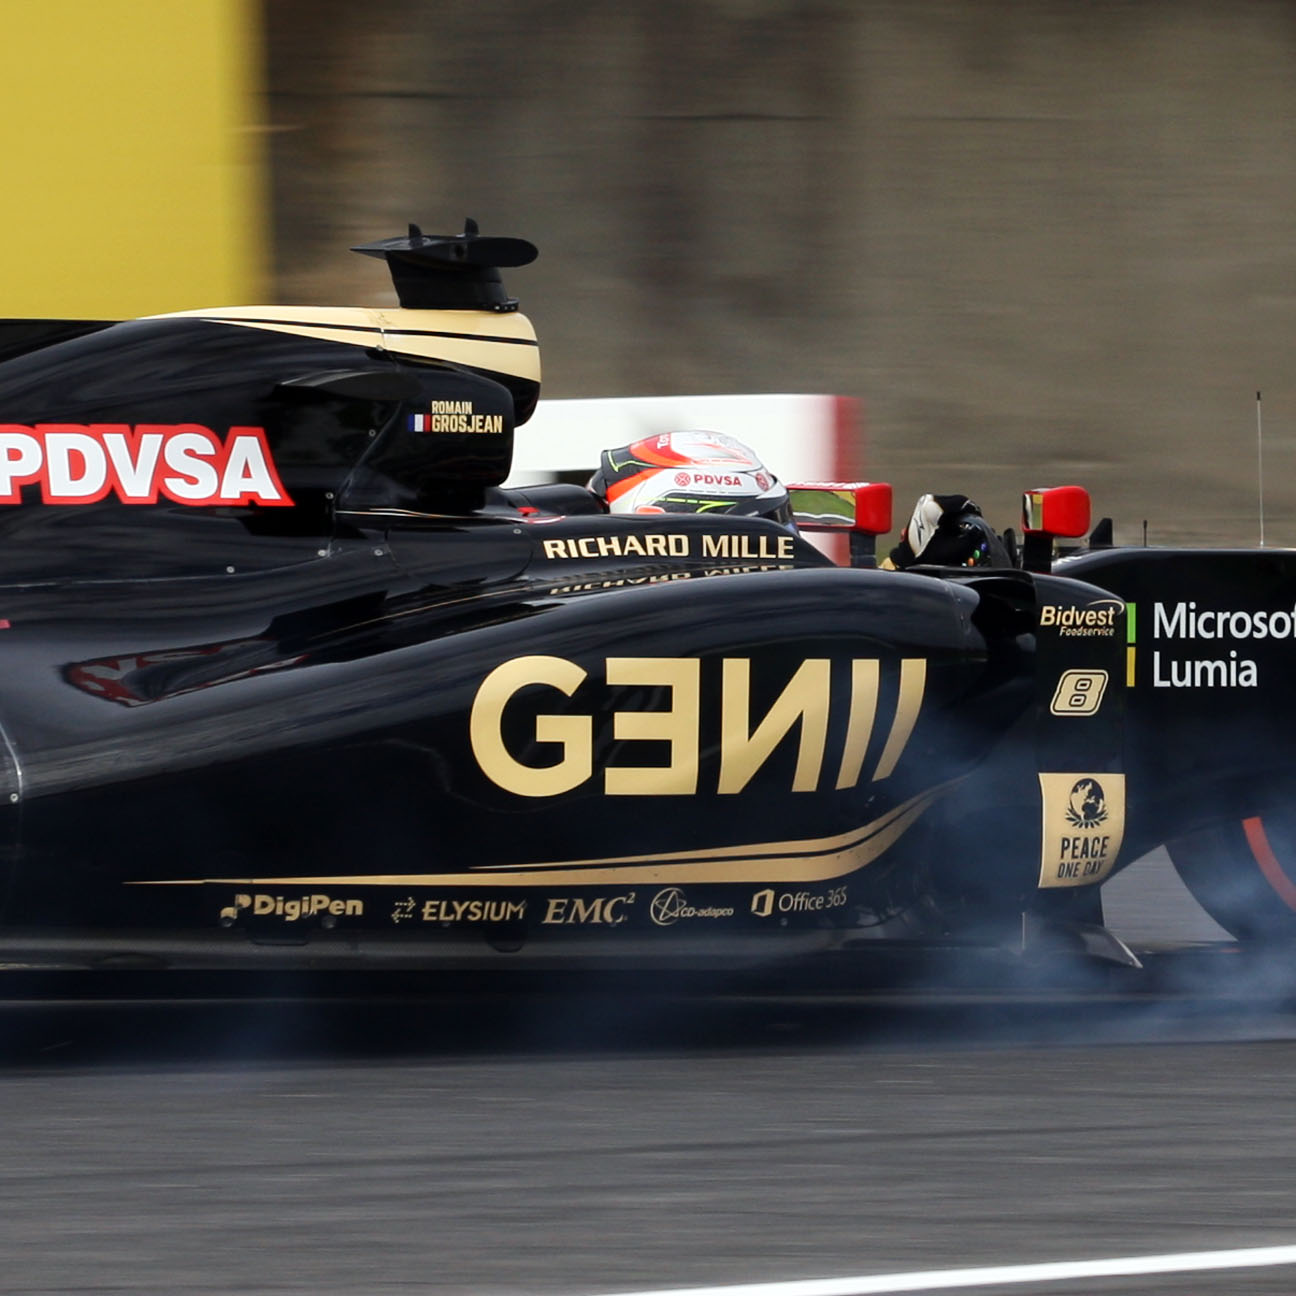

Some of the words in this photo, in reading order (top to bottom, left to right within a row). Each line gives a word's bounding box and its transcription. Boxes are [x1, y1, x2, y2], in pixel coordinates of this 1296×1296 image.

[431, 400, 472, 414] ROMAIN
[431, 414, 503, 433] GROSJEAN
[693, 474, 743, 487] PDVSA
[542, 534, 690, 560] RICHARD
[702, 534, 795, 559] MILLE
[1039, 605, 1116, 626] Bidvest
[1059, 626, 1115, 637] Foodservice
[1152, 650, 1258, 688] Lumia
[1051, 669, 1109, 716] 8
[1060, 836, 1110, 859] PEACE
[1057, 862, 1081, 878] ONE
[254, 894, 364, 922] DigiPen
[422, 899, 527, 921] ELYSIUM
[778, 892, 824, 912] Office
[827, 886, 848, 908] 365
